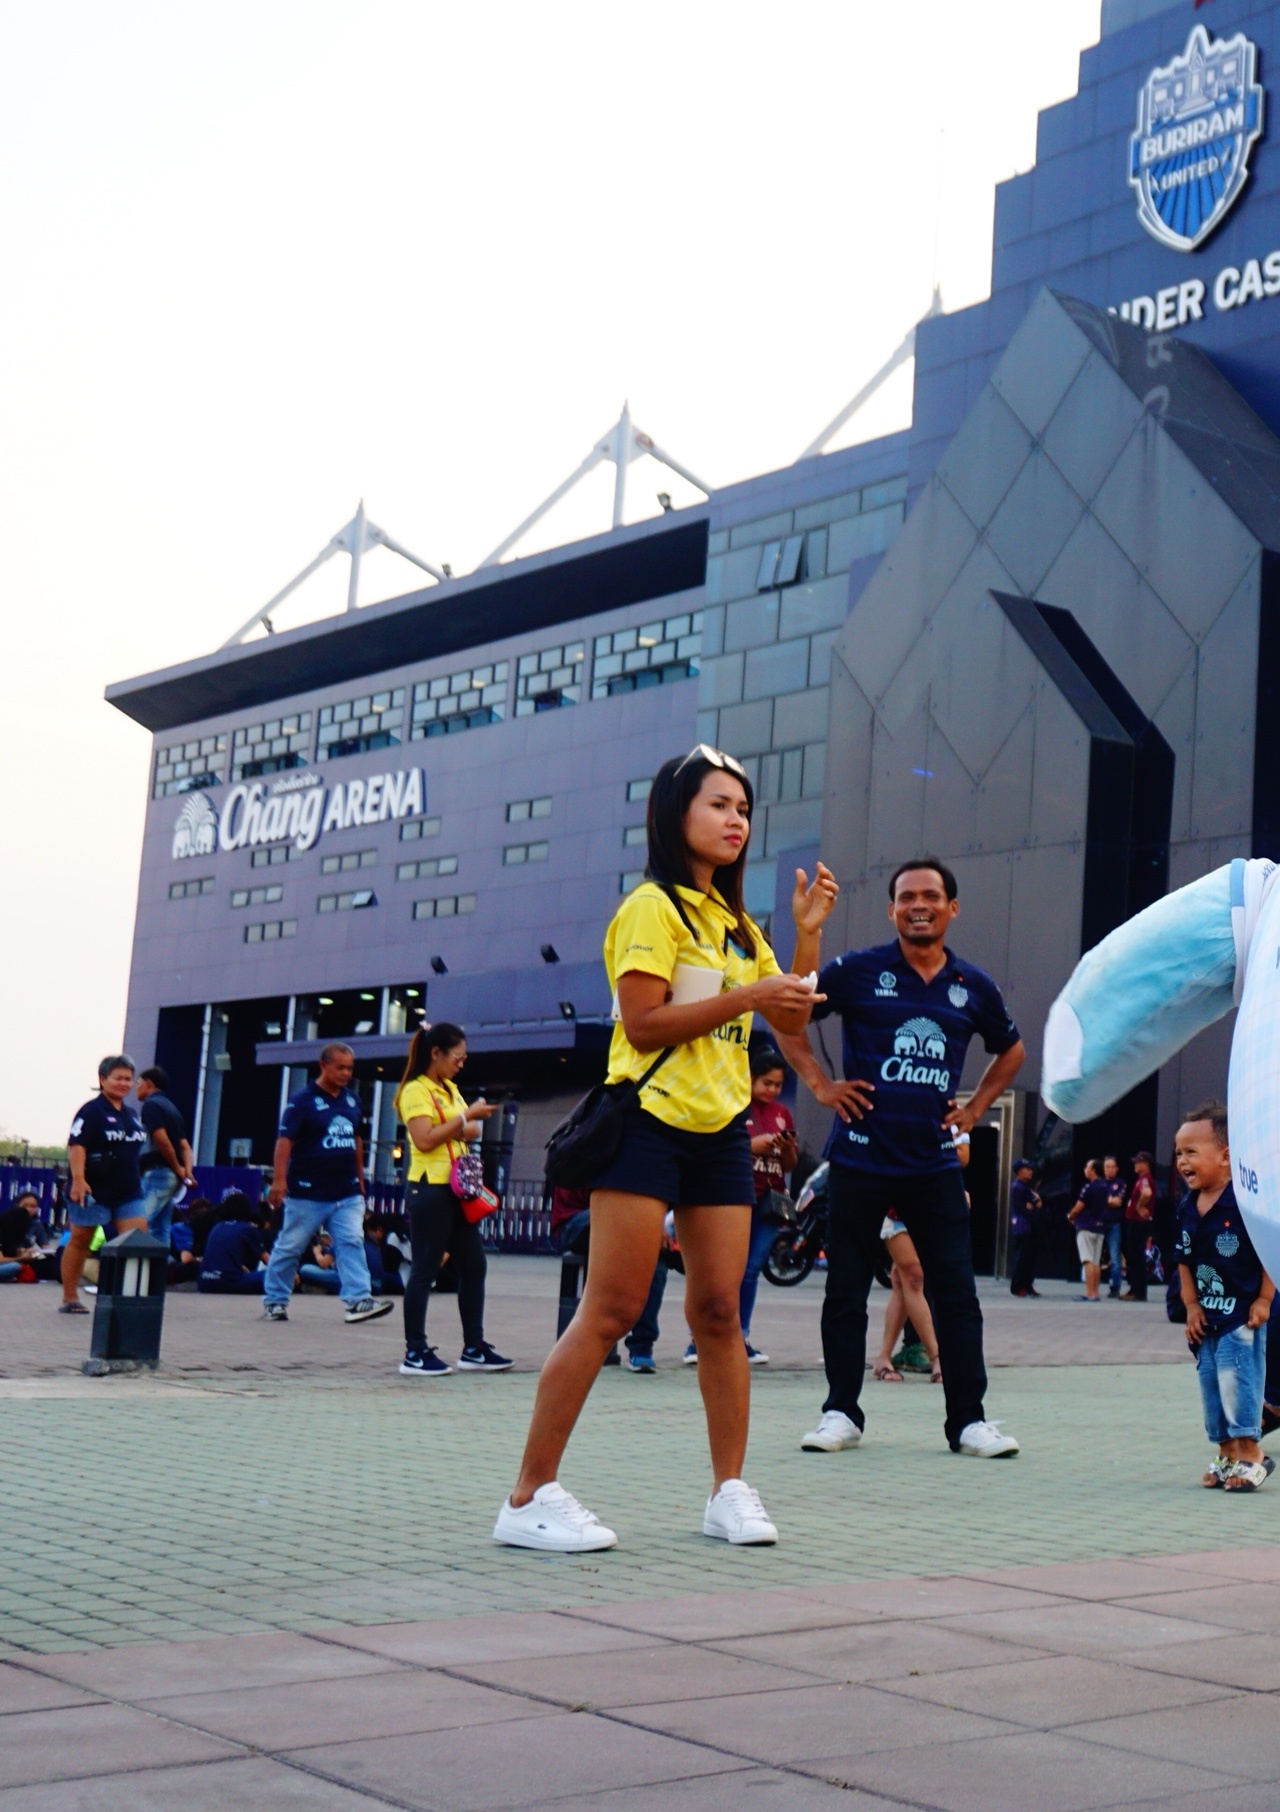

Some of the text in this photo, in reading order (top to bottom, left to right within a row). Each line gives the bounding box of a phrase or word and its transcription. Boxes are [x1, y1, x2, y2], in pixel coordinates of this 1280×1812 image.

[1142, 104, 1244, 163] BURIRAM
[1162, 156, 1219, 190] UNITED
[219, 767, 423, 850] Chang ARENA
[881, 1056, 950, 1092] Chang
[848, 1130, 870, 1145] true
[1239, 1156, 1259, 1195] true
